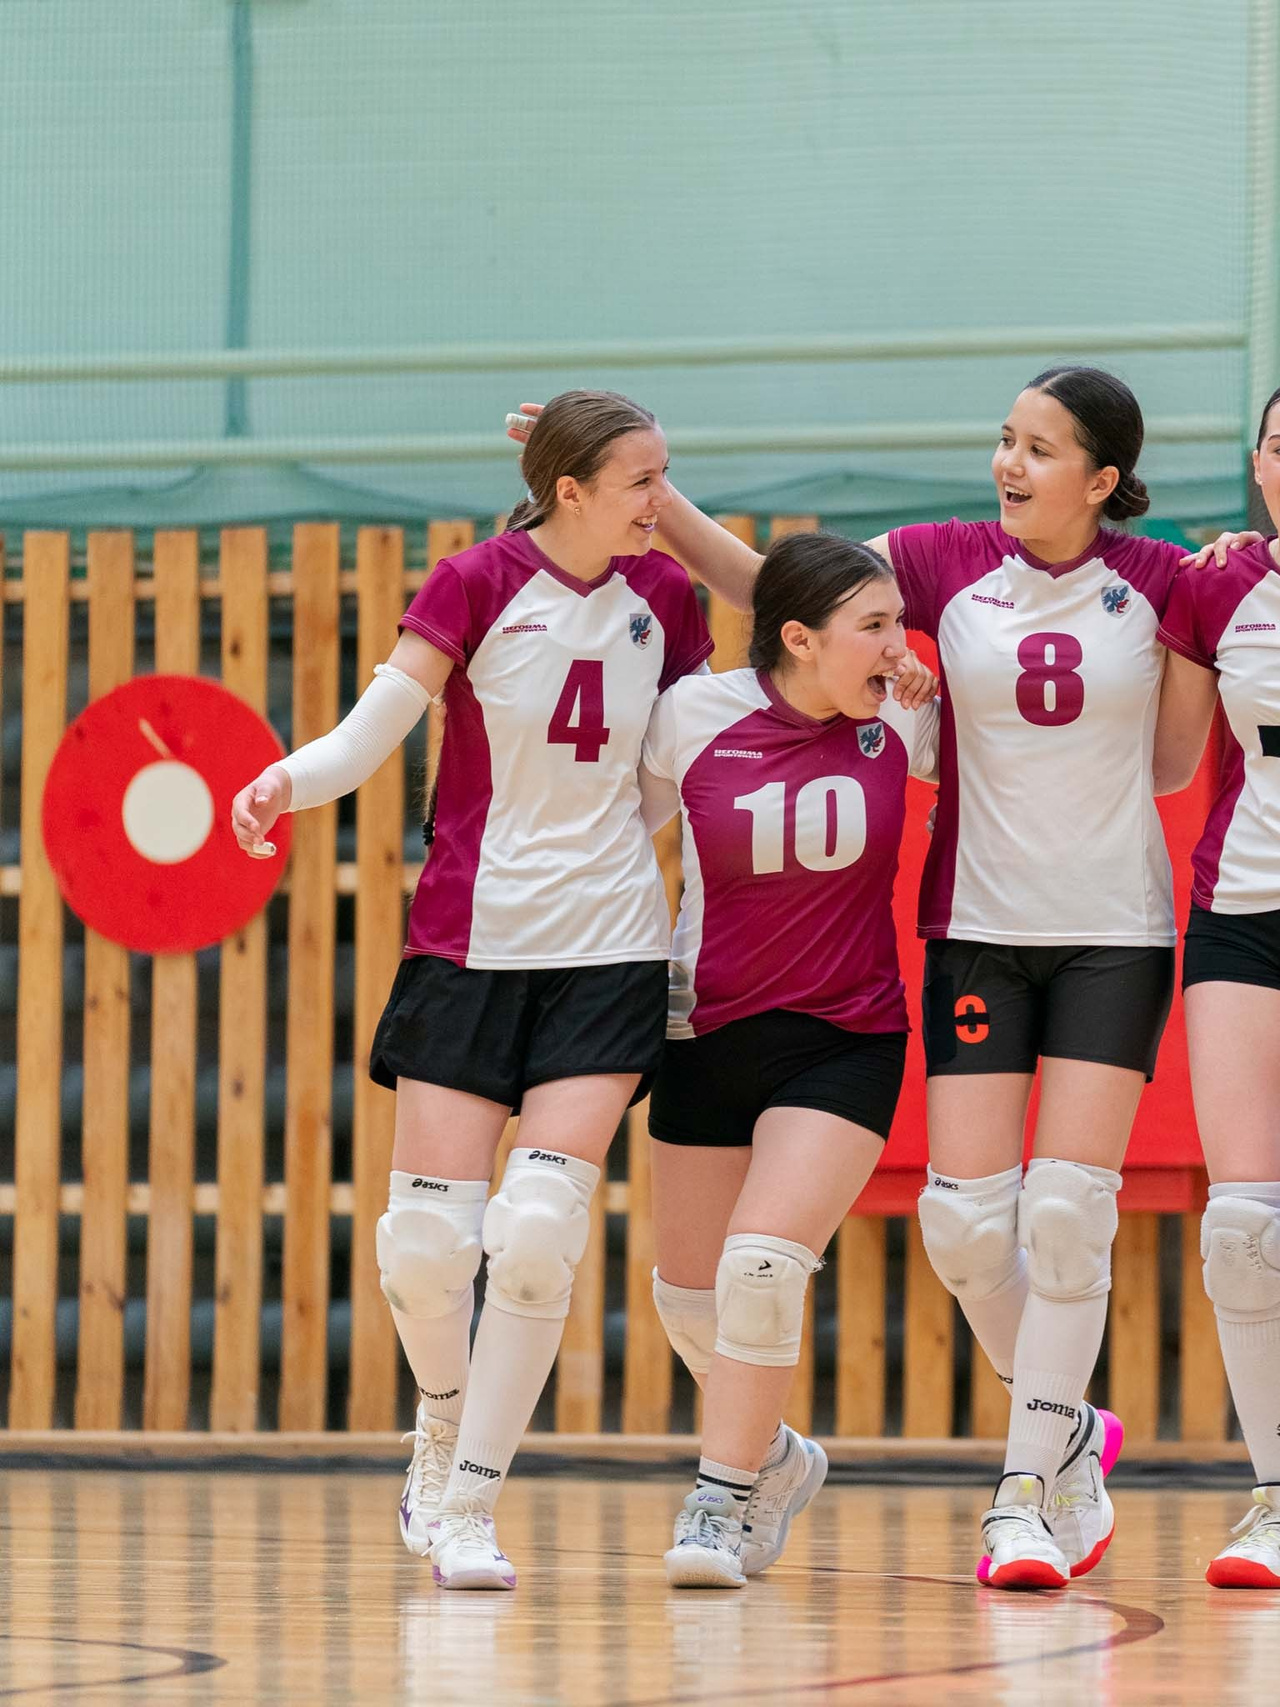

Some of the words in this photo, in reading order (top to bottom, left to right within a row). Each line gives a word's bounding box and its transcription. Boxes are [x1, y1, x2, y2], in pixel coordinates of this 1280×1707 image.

[547, 660, 610, 762] 4
[1015, 632, 1085, 727] 8
[734, 775, 867, 875] 10
